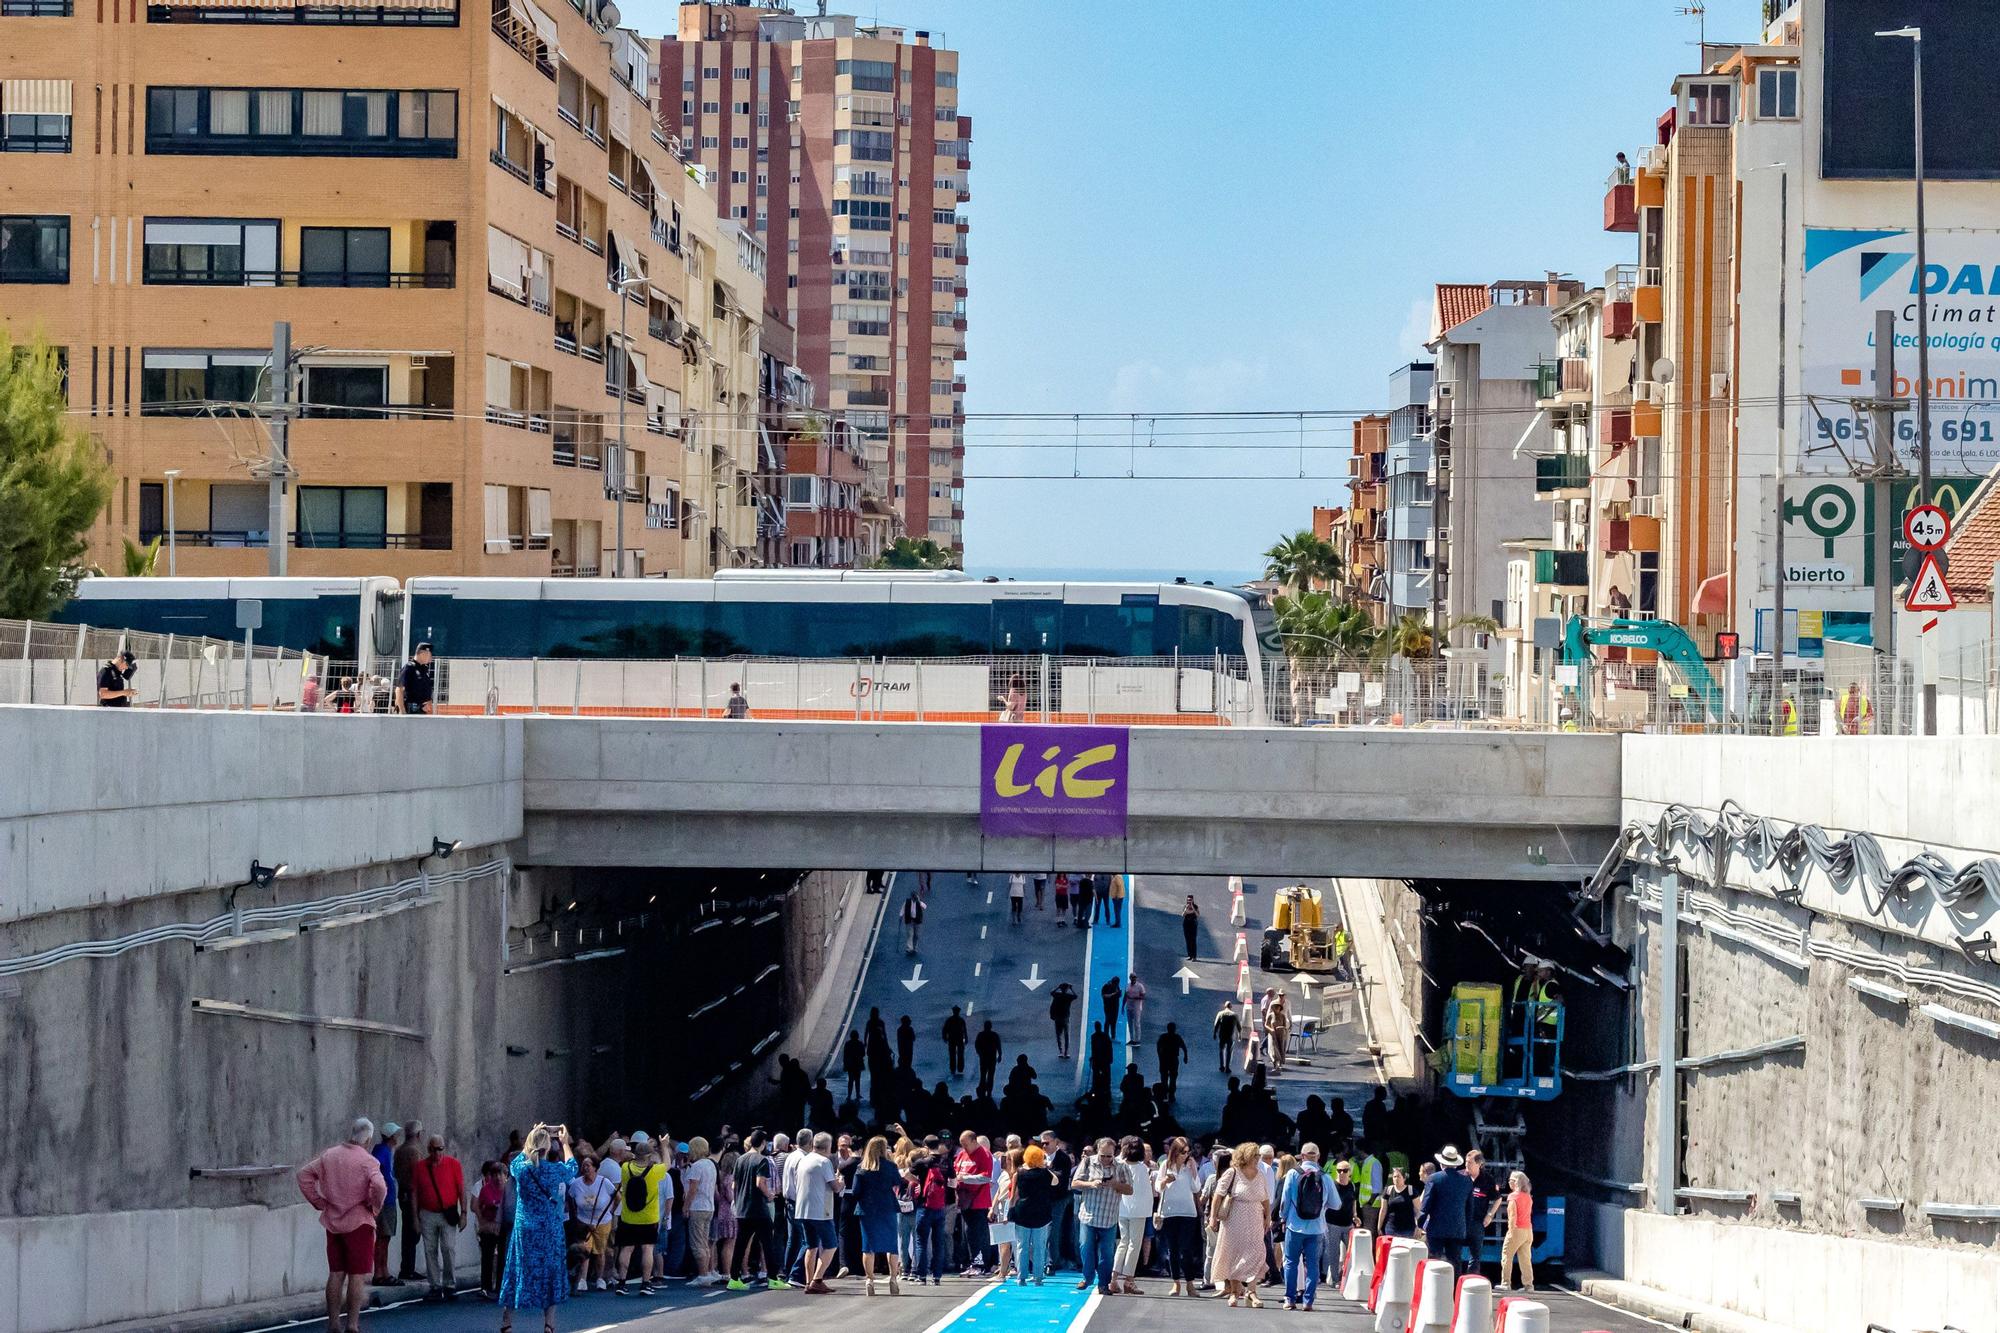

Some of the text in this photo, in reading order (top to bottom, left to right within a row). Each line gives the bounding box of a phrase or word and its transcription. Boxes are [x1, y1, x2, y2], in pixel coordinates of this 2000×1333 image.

[1903, 303, 1996, 323] Cimat
[1817, 417, 1870, 440] 965
[1941, 419, 1994, 442] 691
[1609, 634, 1649, 645] KOBELCO
[873, 682, 911, 692] TRAM
